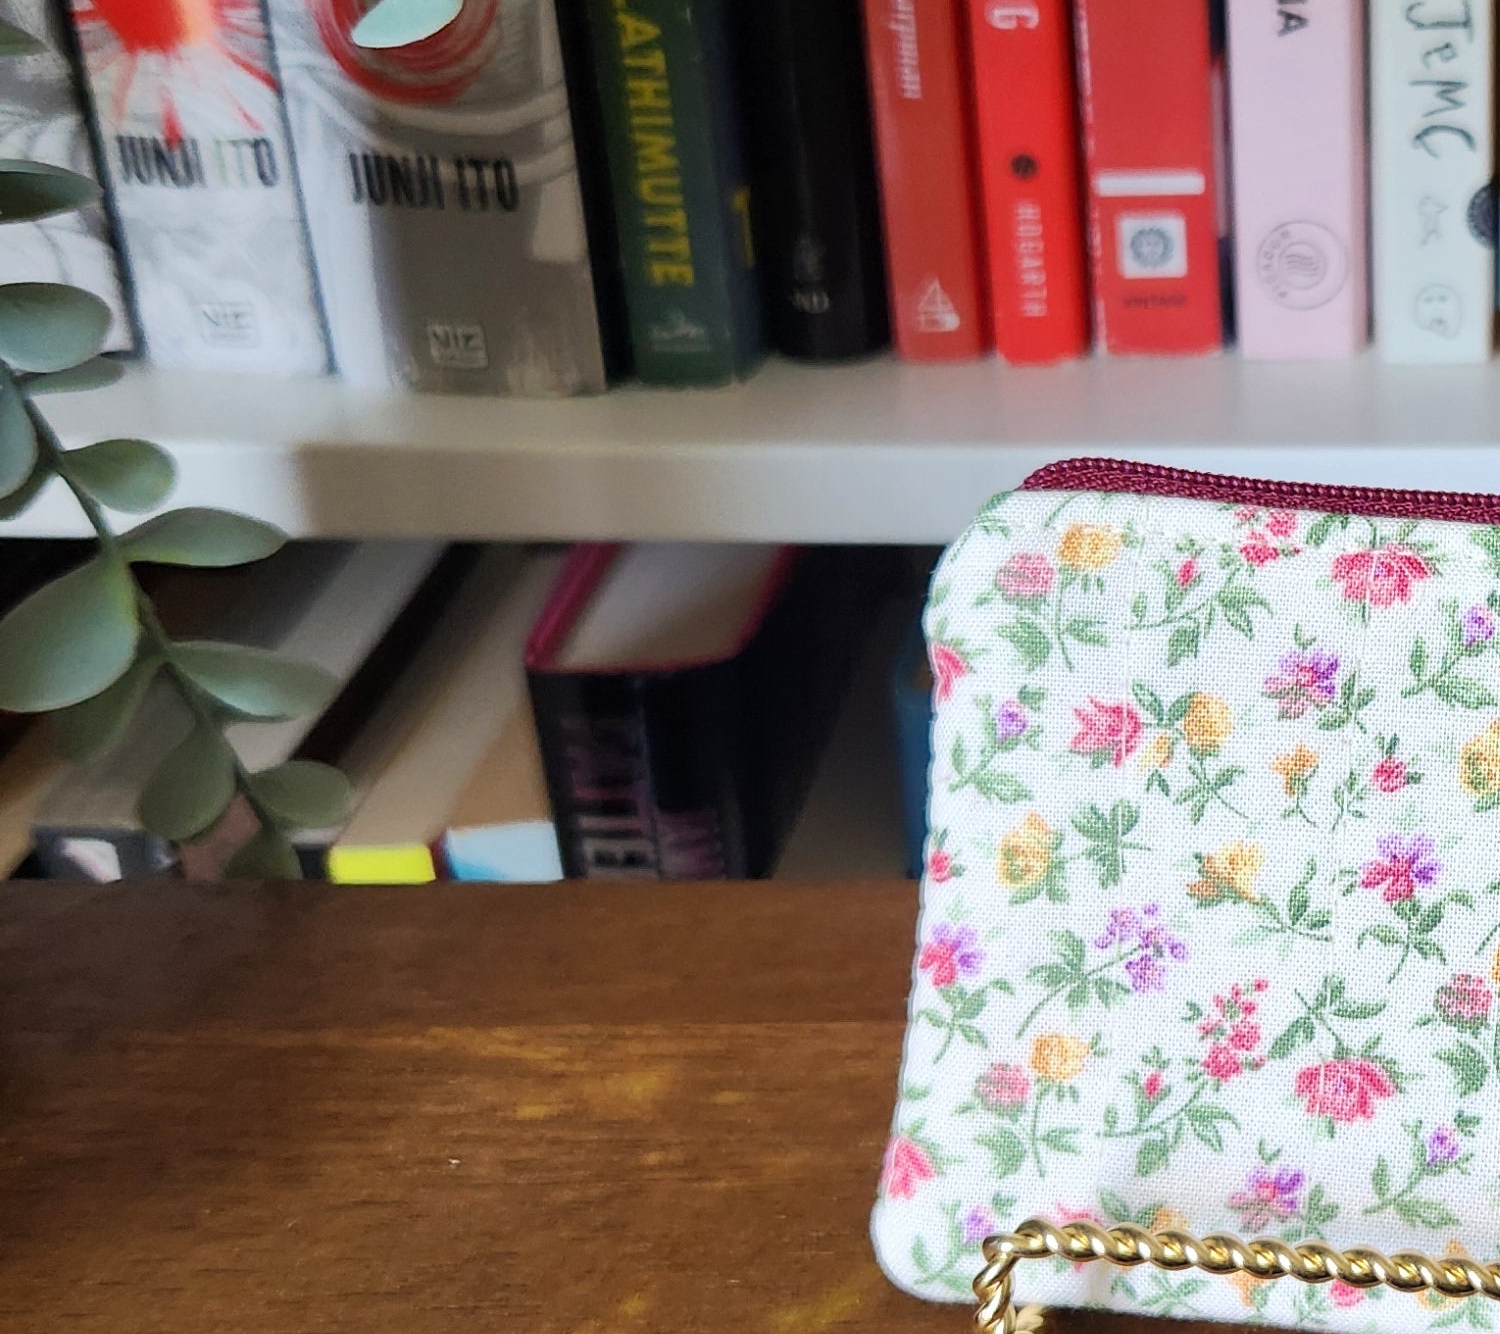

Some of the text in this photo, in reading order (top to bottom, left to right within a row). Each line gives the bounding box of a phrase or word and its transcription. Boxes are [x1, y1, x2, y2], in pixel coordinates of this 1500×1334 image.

[348, 152, 522, 213] JUNJI ITO
[1013, 203, 1049, 318] HOGARTH
